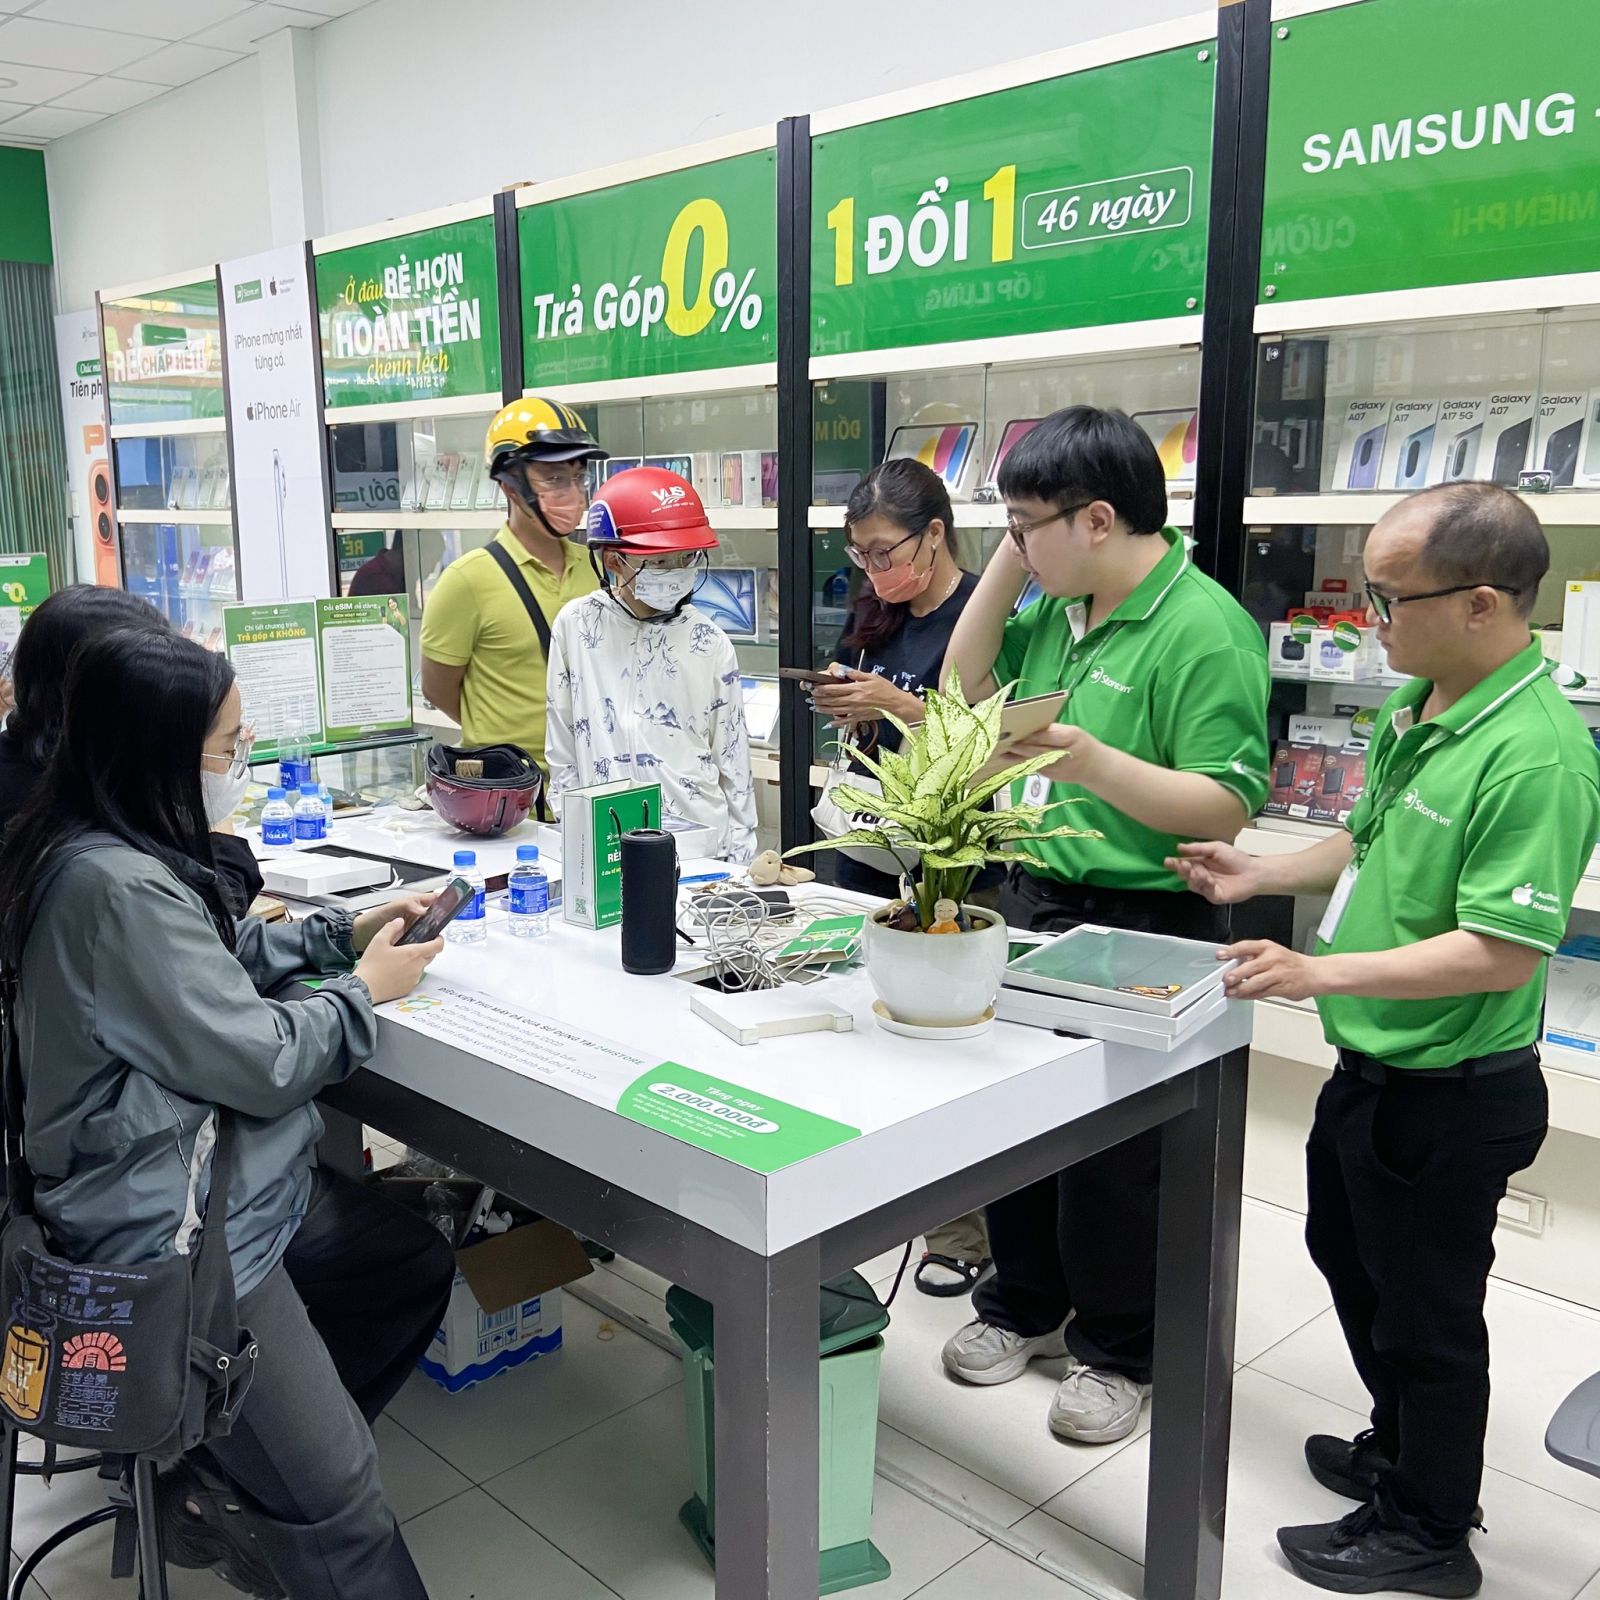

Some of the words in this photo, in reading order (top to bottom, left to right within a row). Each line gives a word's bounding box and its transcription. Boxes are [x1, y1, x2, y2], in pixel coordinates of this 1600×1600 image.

[1301, 92, 1576, 174] SAMSUNG
[828, 197, 854, 286] 1
[864, 176, 969, 275] ĐỔI
[983, 164, 1017, 263] 1
[1036, 195, 1080, 234] 46
[1088, 183, 1176, 231] ngày
[358, 278, 384, 303] đâu
[415, 252, 464, 291] HƠN
[533, 283, 584, 339] Trả
[593, 275, 666, 337] Góp
[335, 306, 410, 358] HOÀN
[415, 288, 481, 347] TIỀN
[234, 332, 261, 350] iPhone
[70, 380, 89, 398] Tiên
[91, 379, 103, 400] ph
[1491, 394, 1532, 404] Galaxy
[1541, 395, 1582, 406] Galaxy
[254, 402, 288, 421] iPhone
[289, 399, 302, 418] Air
[1350, 401, 1386, 411] Galaxy
[1395, 402, 1433, 413] Galaxy
[1443, 400, 1482, 411] Galaxy
[1441, 412, 1457, 420] A17
[1458, 411, 1473, 420] 5G
[1540, 407, 1556, 416] A17
[335, 603, 353, 611] eSIM
[276, 628, 306, 638] KHÔNG
[1296, 723, 1323, 731] HAVIT
[657, 1086, 768, 1129] 2.000.000đ
